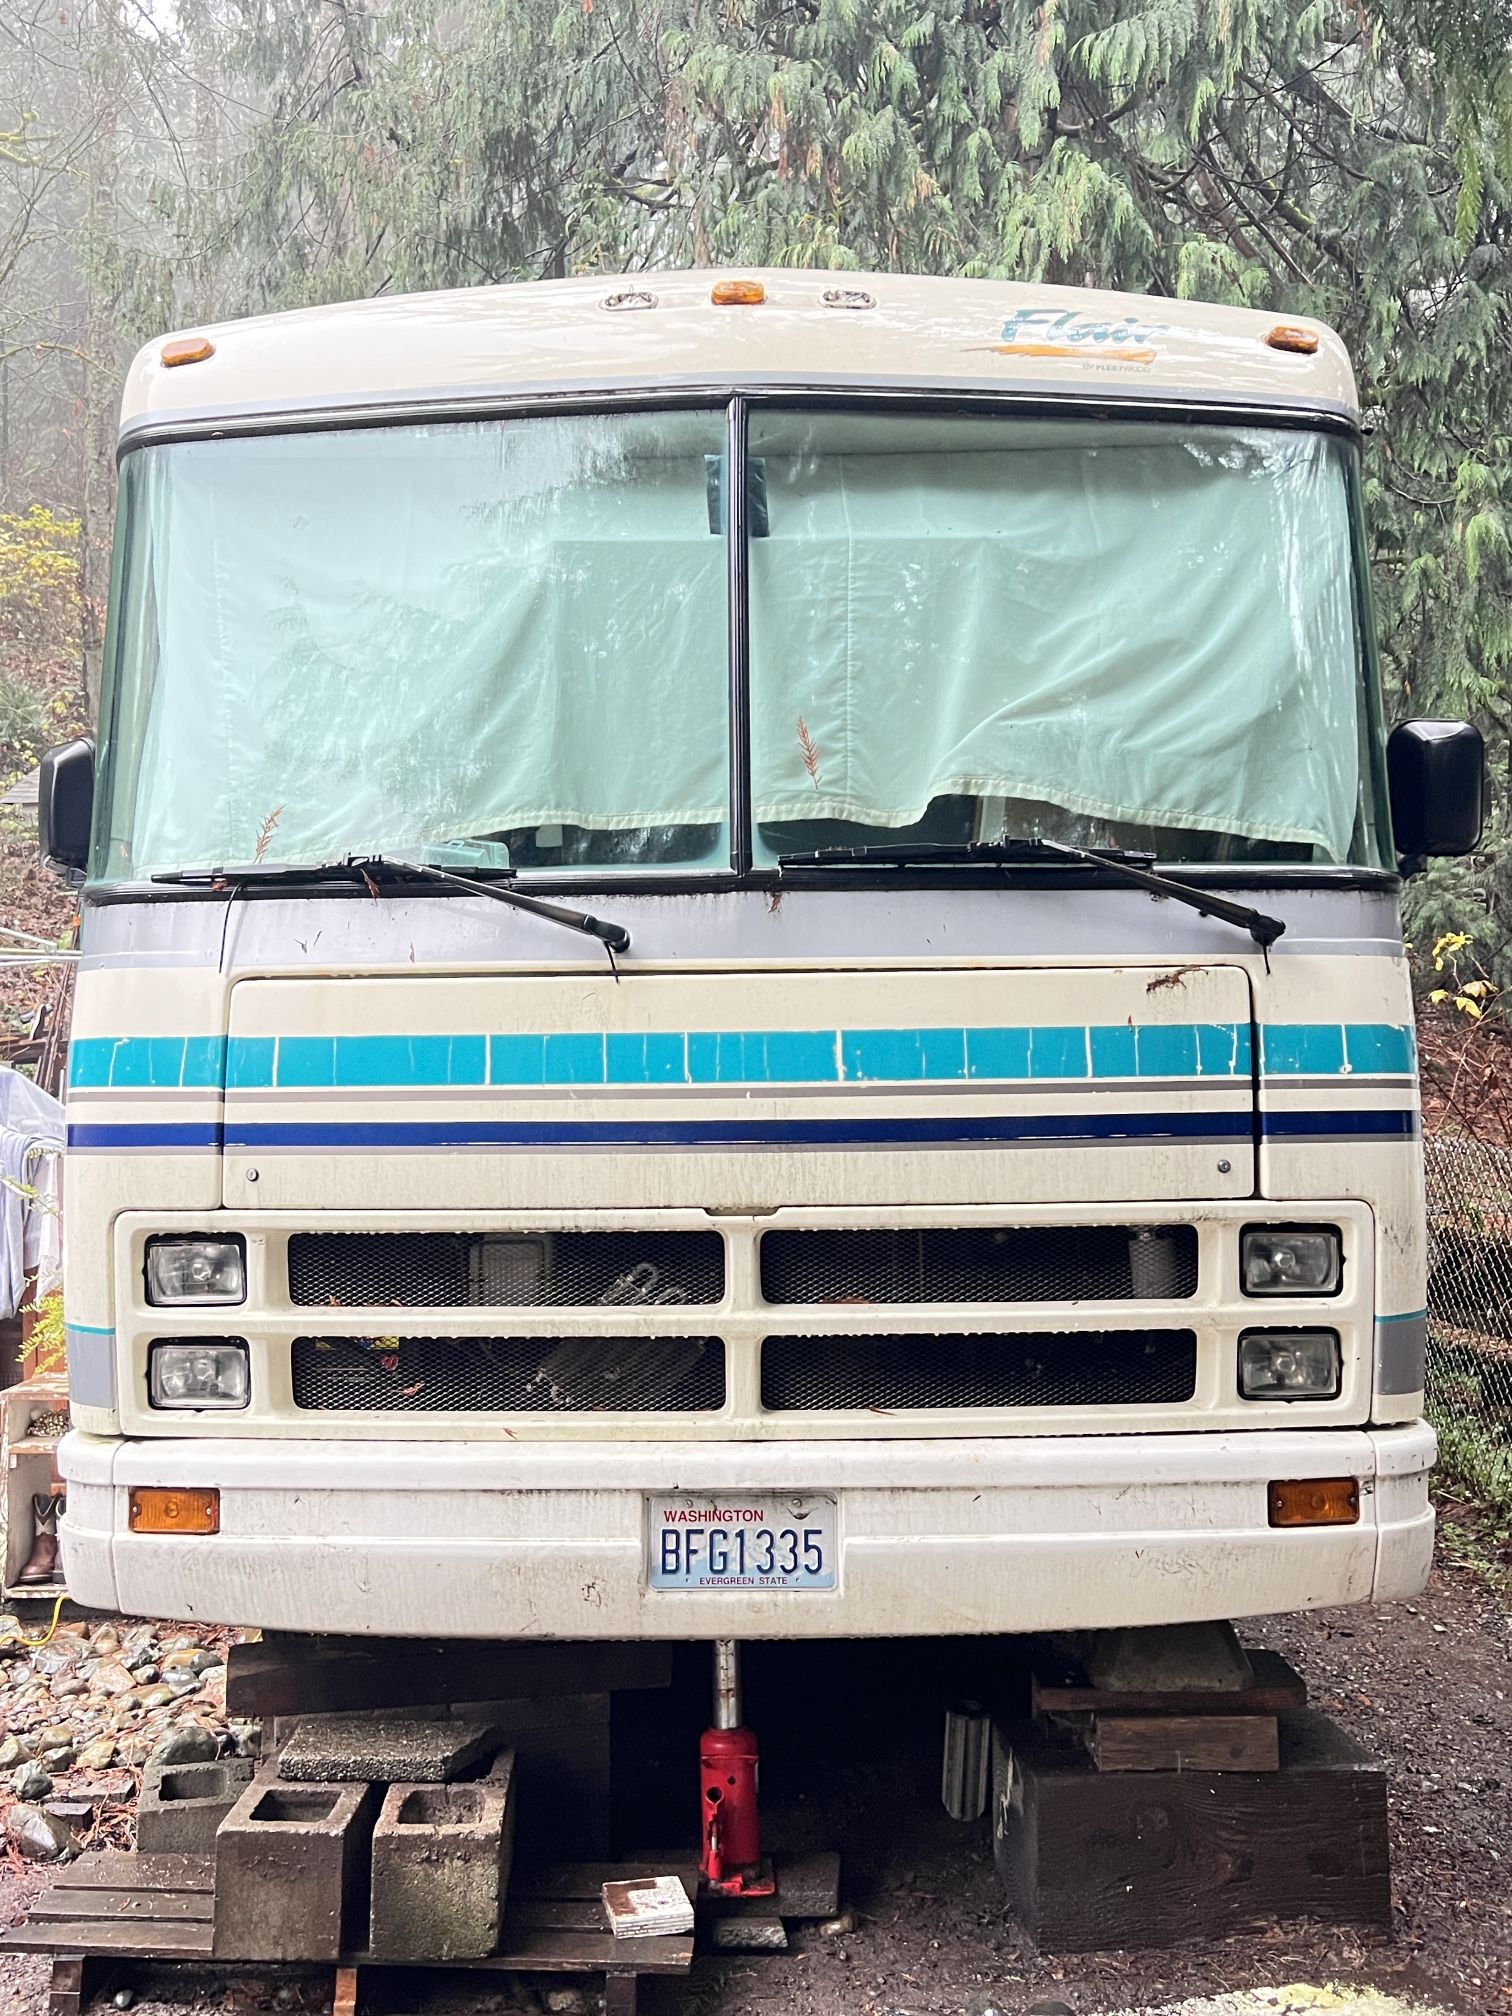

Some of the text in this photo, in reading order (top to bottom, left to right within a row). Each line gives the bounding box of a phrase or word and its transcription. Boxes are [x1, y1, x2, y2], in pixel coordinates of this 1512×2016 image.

[1001, 309, 1168, 344] Flair
[664, 1510, 764, 1522] WASHINGTON
[661, 1528, 823, 1575] BFG1335
